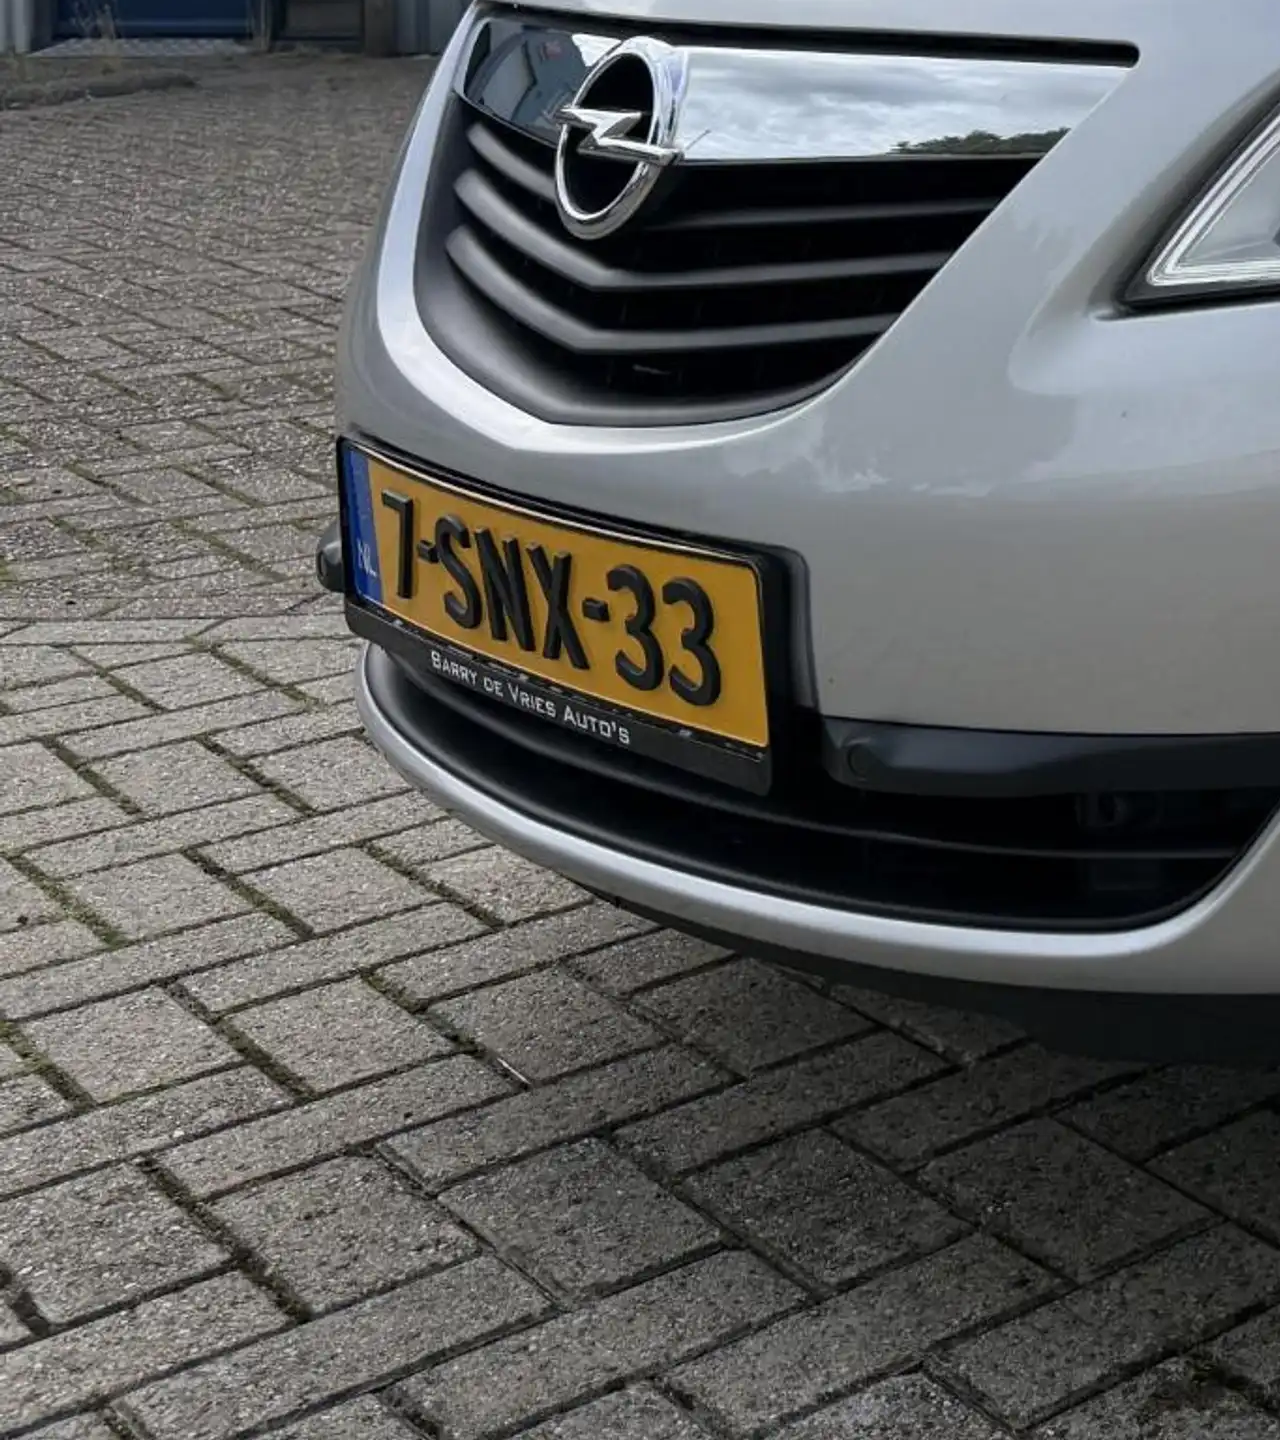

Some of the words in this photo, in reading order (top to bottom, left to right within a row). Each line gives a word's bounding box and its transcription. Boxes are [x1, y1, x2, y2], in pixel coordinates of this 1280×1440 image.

[381, 490, 721, 707] 7-SNX-33
[430, 649, 478, 686] BARRY
[508, 682, 557, 719] VRIES
[563, 704, 631, 746] AUTO'S
